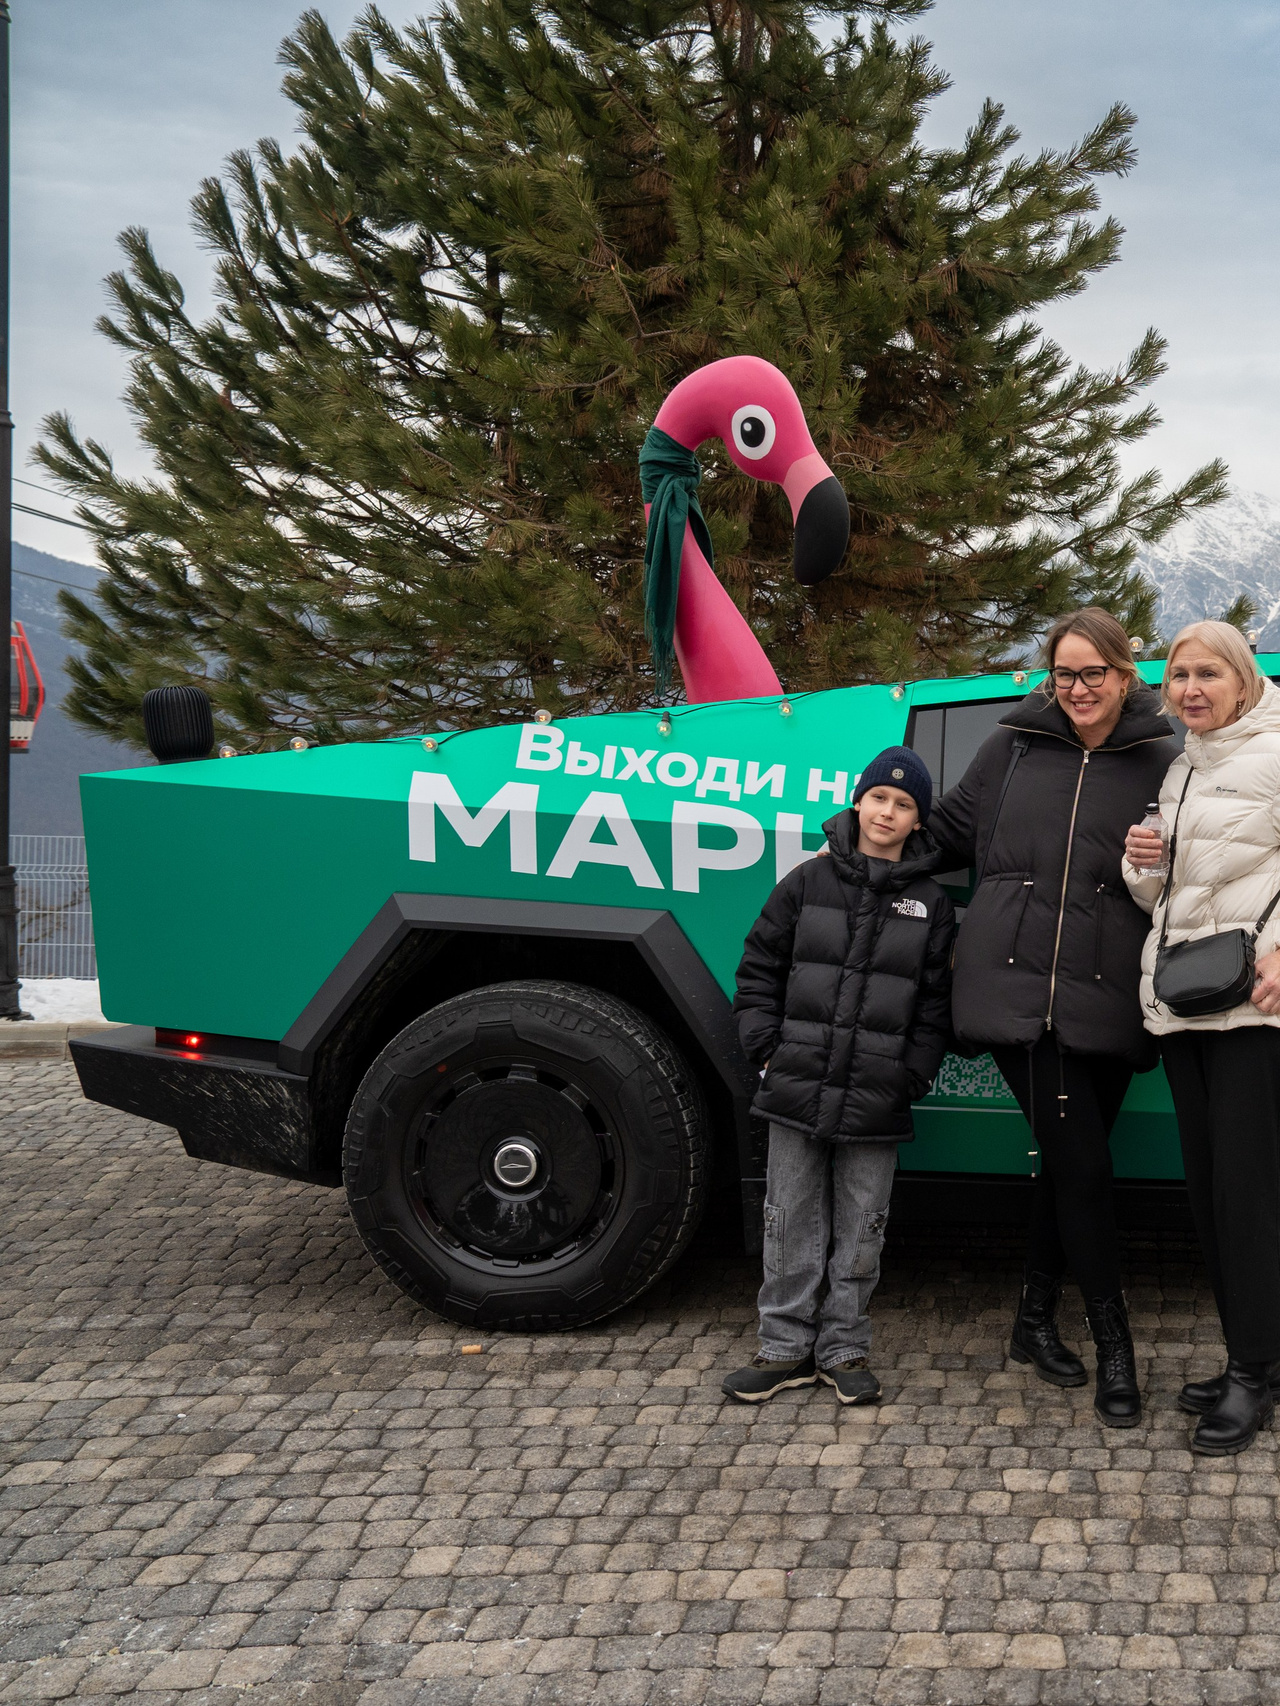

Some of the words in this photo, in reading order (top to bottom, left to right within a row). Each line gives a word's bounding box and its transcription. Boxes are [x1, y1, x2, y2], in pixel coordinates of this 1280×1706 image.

[515, 723, 786, 801] Выходи
[892, 902, 915, 910] NORTH
[897, 908, 915, 916] FACE
